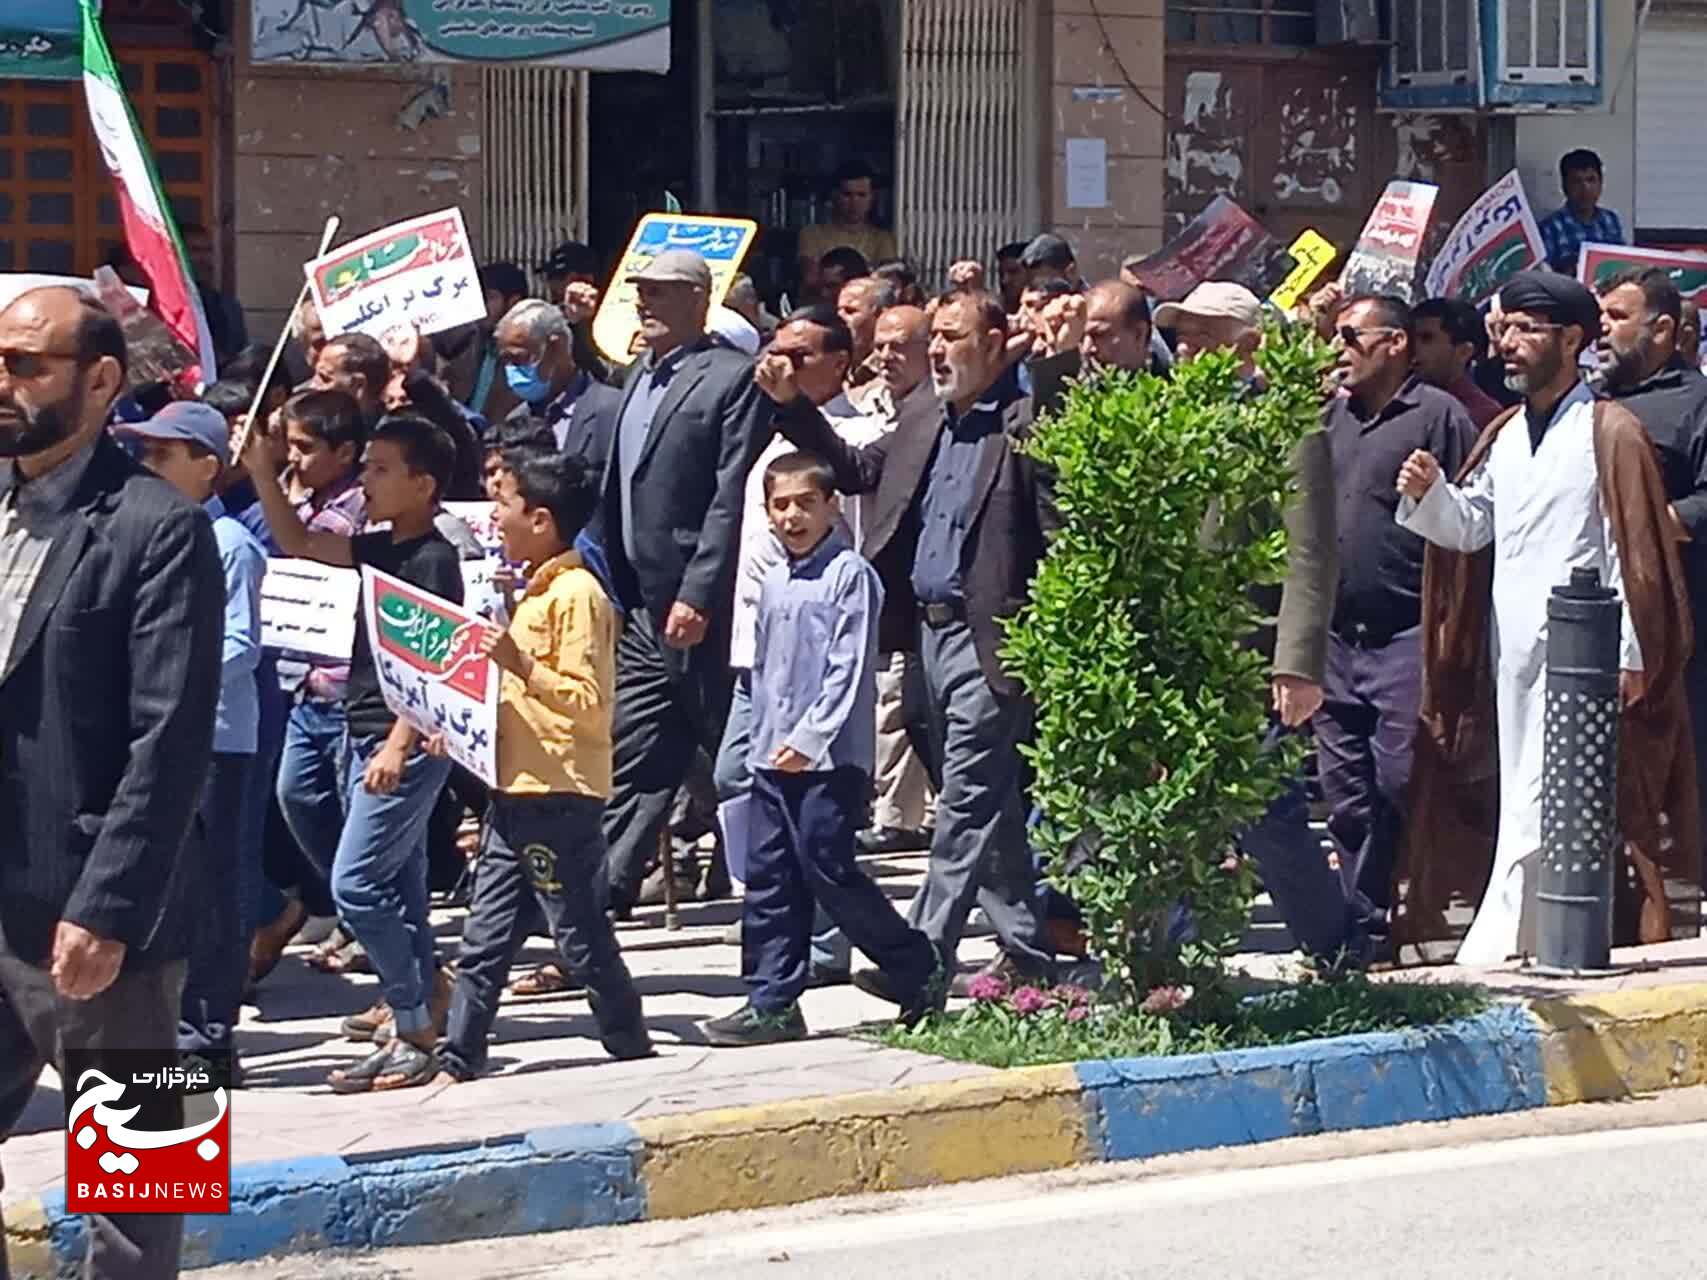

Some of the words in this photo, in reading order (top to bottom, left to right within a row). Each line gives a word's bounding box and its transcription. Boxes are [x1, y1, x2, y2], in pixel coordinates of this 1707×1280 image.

[422, 276, 469, 299] مرگ
[378, 602, 428, 651] ایران
[450, 709, 488, 751] مرگ
